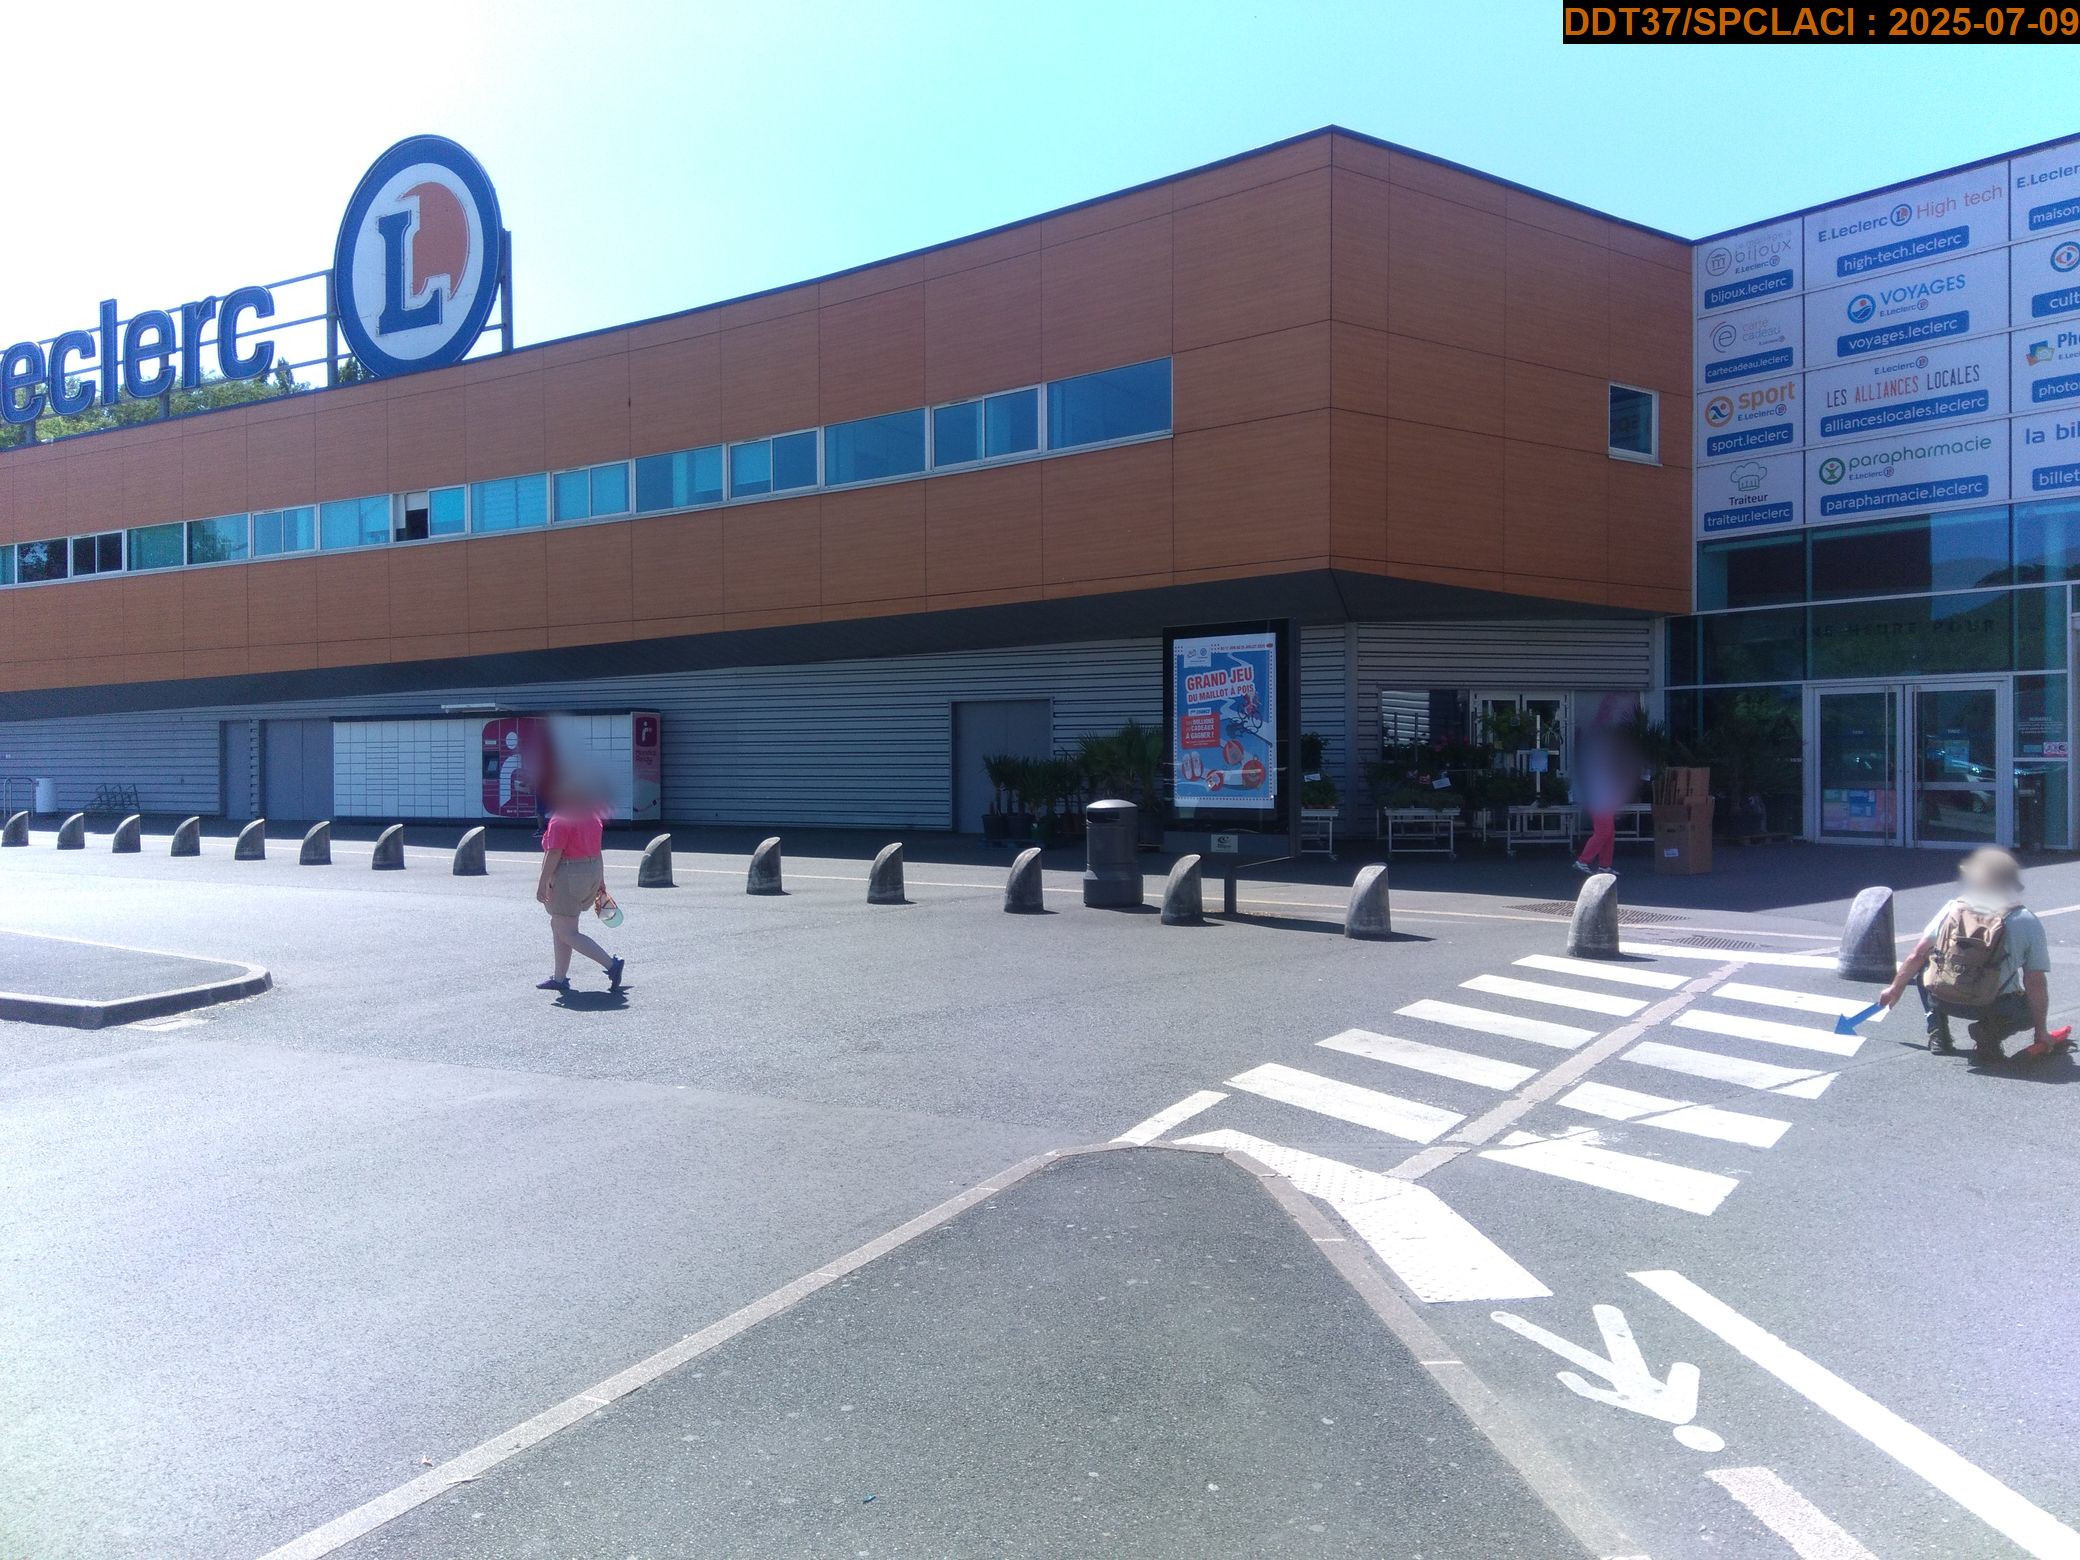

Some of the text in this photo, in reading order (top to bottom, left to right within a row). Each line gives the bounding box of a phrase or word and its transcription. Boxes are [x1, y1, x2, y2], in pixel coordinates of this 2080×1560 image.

[1818, 217, 1888, 242] E.Leclerc
[1917, 197, 1957, 218] High
[1964, 185, 2002, 207] tech
[1735, 240, 1791, 263] bijoux
[1844, 233, 1962, 271] high-tech.leclerc
[1711, 277, 1787, 302] bijoux.leclerc
[1880, 274, 1966, 305] VOYAGES
[1880, 304, 1917, 317] E.Leclerc
[1849, 318, 1958, 350] voyages.leclerc
[0, 285, 275, 424] eclerc
[1707, 355, 1789, 378] cartecadeau.leclerc
[1874, 362, 1915, 375] E.Leclerc
[1738, 381, 1796, 410] sport
[1827, 365, 1980, 408] LES ALLIANCES LOCALES
[1738, 410, 1775, 421] E.Leclerc
[1825, 396, 1985, 433] allianceslocales.leclerc
[1712, 430, 1788, 452] sport.leclerc
[2025, 428, 2045, 444] la
[1849, 436, 1992, 471] parapharmacie
[1728, 494, 1768, 506] Traiteur
[1826, 481, 1984, 513] parapharmacie.leclerc
[1707, 508, 1790, 526] traiteur.leclerc
[1187, 666, 1252, 691] GRAND JEU
[1188, 693, 1198, 703] DU
[1200, 688, 1228, 700] MAILLOT
[1237, 683, 1253, 694] POIS
